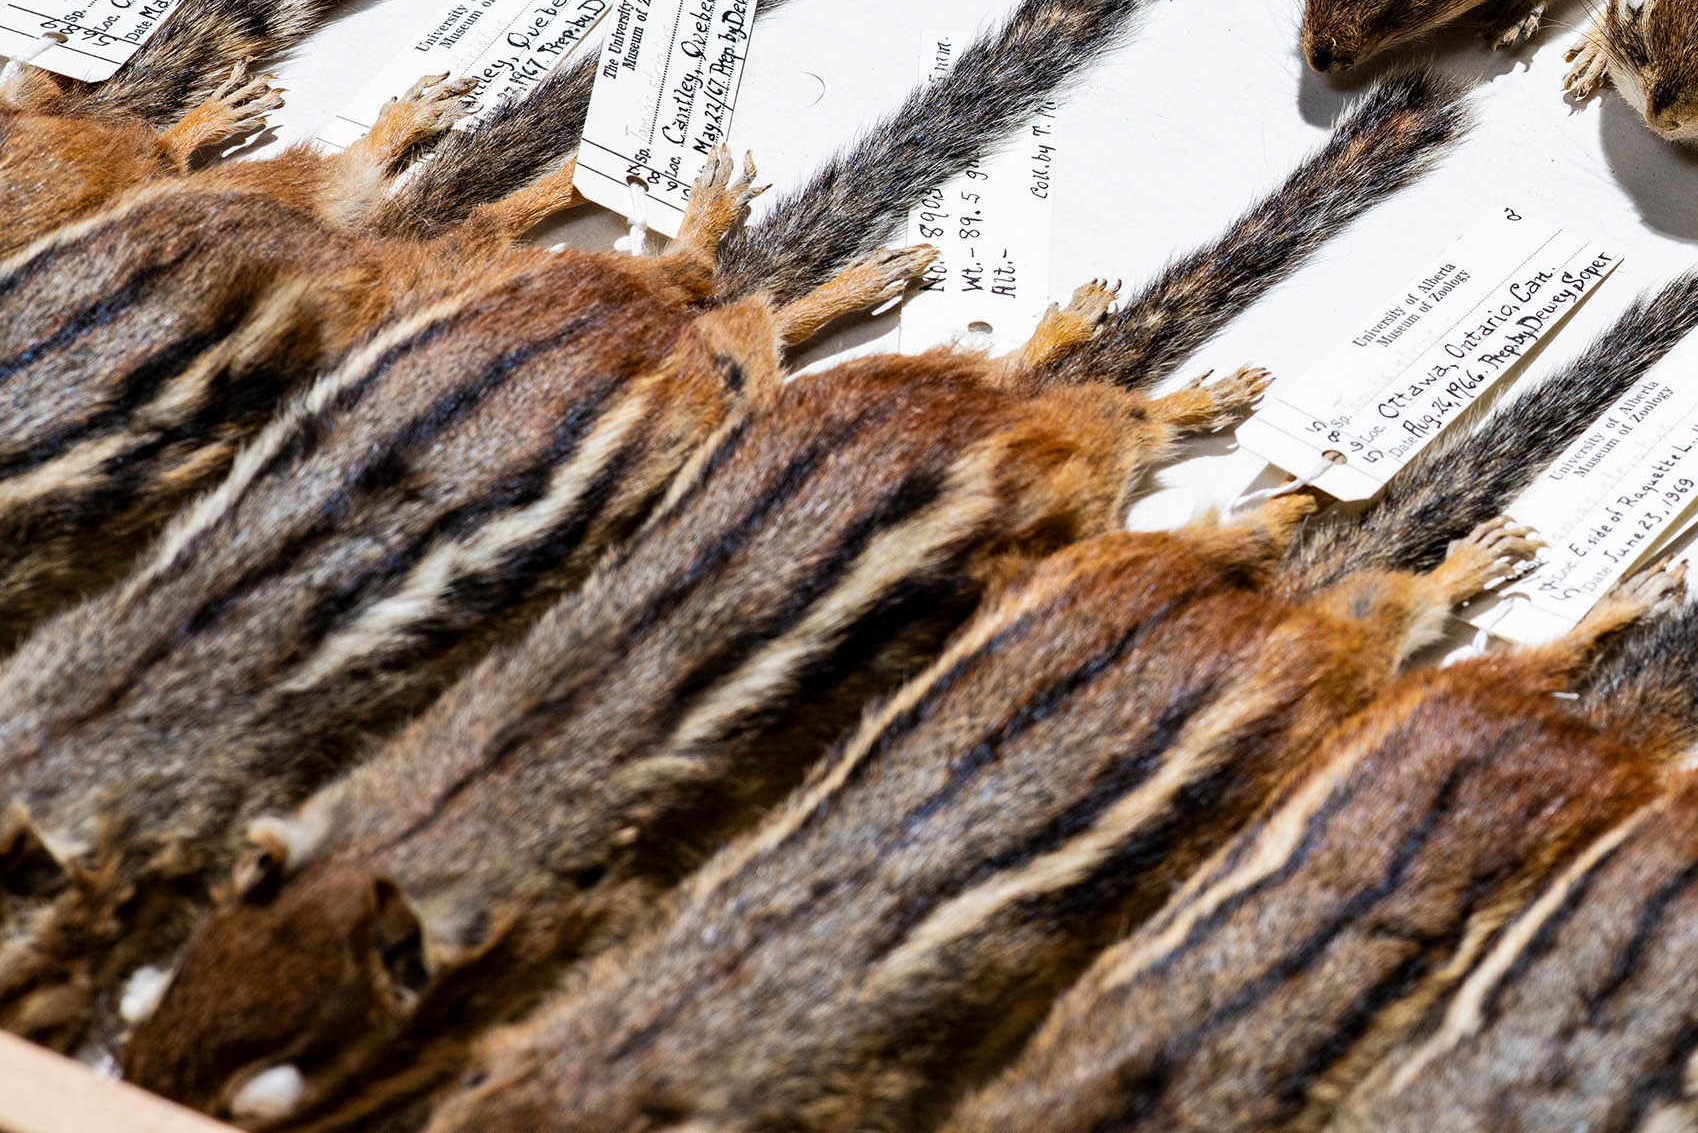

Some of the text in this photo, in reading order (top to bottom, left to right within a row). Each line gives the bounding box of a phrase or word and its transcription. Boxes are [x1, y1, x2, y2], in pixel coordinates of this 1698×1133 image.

[64, 10, 87, 26] Sp.
[100, 15, 120, 32] Loc.
[124, 15, 152, 45] Date
[414, 5, 468, 51] University
[438, 11, 483, 49] Museum
[608, 0, 634, 54] University
[622, 26, 644, 71] Museum
[635, 8, 648, 22] of
[603, 59, 619, 79] The
[662, 68, 704, 145] Cantley,
[635, 147, 652, 164] Sp.
[692, 123, 724, 156] May
[667, 155, 682, 179] Loc.
[920, 260, 949, 292] No.
[1517, 289, 1579, 335] Dewey
[1561, 252, 1613, 293] Soper
[1352, 264, 1456, 347] University of Alberta
[1377, 270, 1471, 347] Museum of Zoology
[1378, 364, 1459, 419] Ottawa,
[1444, 305, 1520, 361] Ontario,
[1510, 268, 1558, 304] Can.
[1548, 382, 1659, 480] University of Alberta
[1573, 386, 1674, 478] Museum of Zoology
[1588, 525, 1612, 545] side
[1605, 507, 1623, 522] of
[1616, 455, 1680, 507] Raquette
[1603, 533, 1645, 563] June
[1662, 479, 1694, 507] 1969
